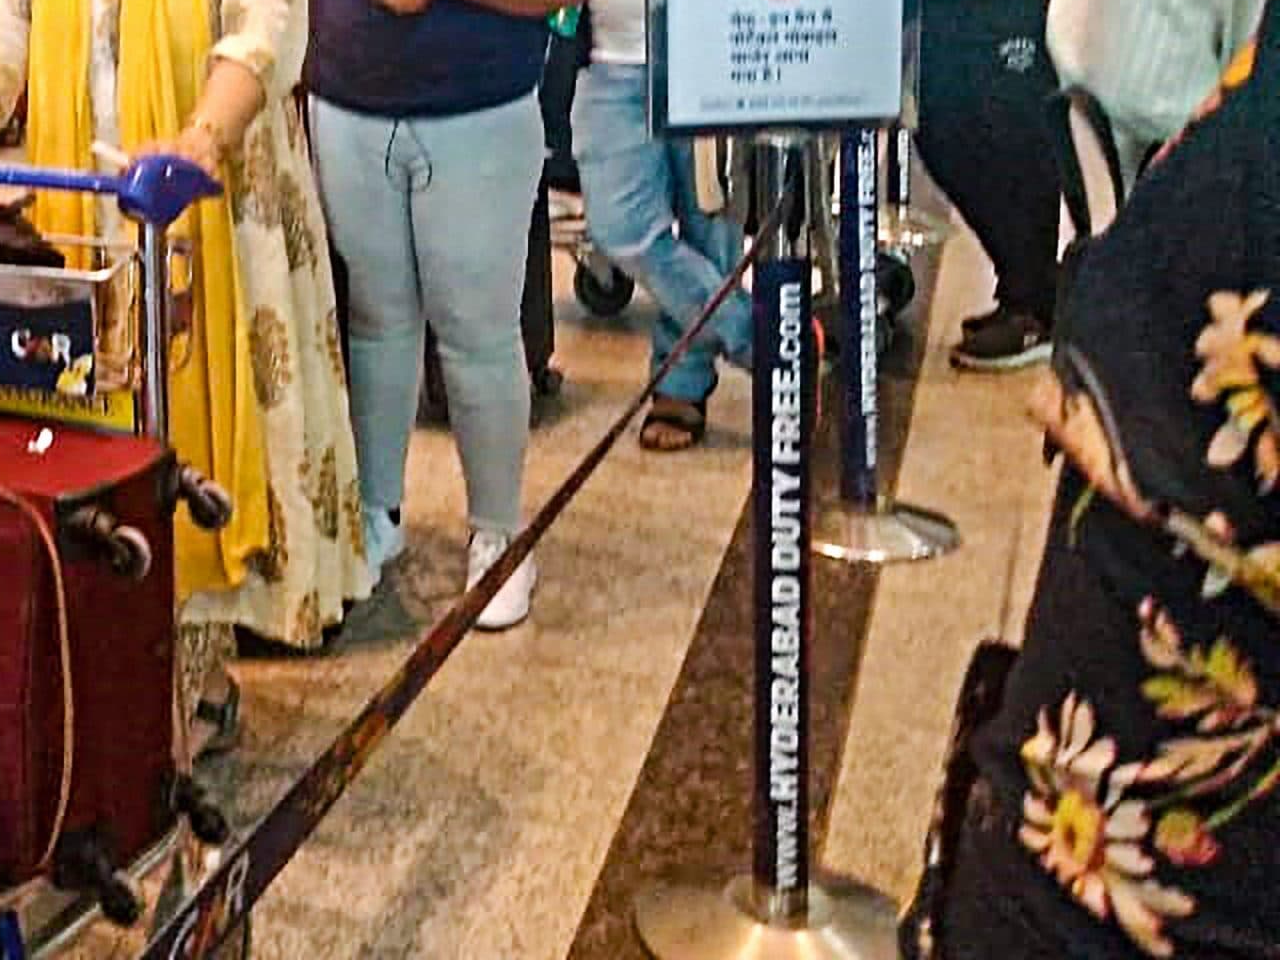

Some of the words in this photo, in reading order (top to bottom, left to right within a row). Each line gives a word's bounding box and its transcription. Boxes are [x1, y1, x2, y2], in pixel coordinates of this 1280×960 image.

[771, 282, 803, 464] FREE.com
[771, 466, 801, 570] DUTY
[771, 576, 801, 889] www.HYDERABAD
